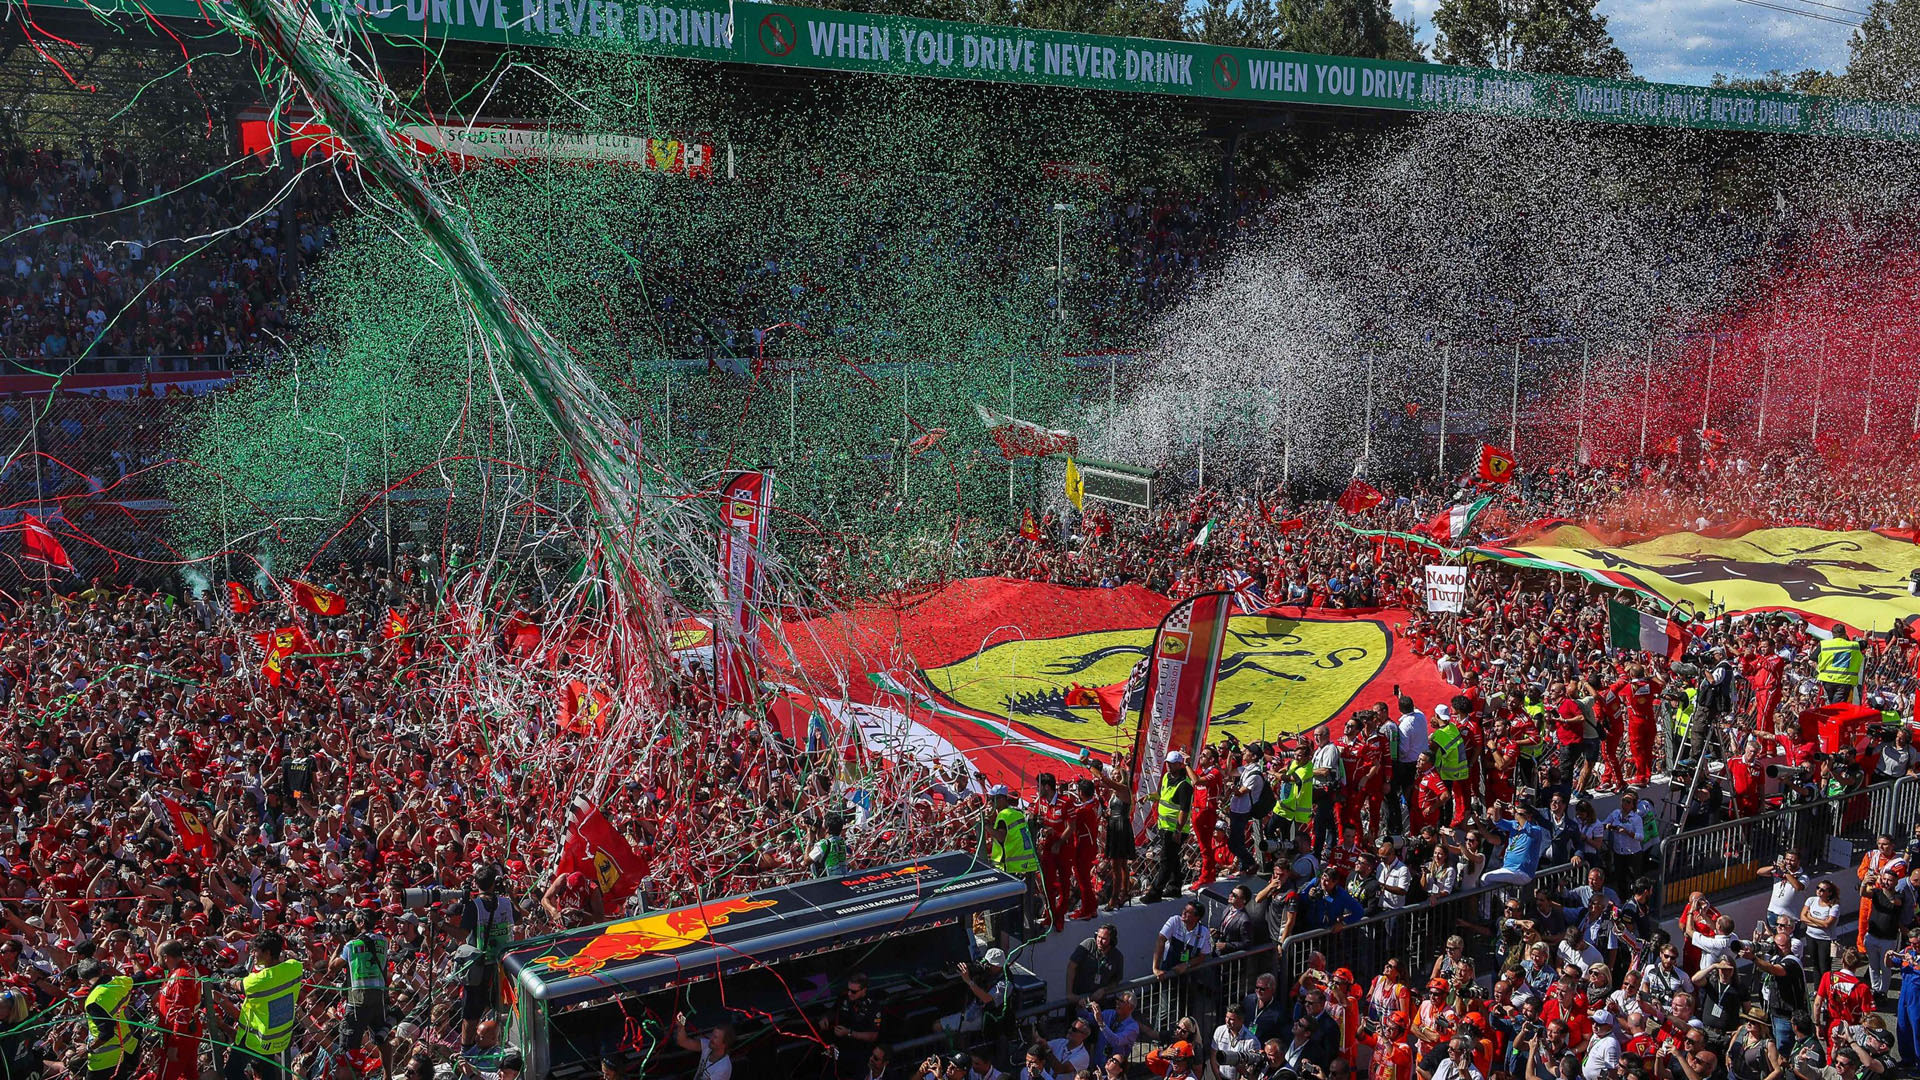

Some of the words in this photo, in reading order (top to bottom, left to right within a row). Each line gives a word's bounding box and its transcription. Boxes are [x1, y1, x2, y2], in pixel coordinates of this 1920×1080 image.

[522, 0, 624, 40] NEVER
[638, 4, 733, 50] DRINK
[807, 20, 891, 62] WHEN
[900, 28, 953, 68] YOU
[963, 35, 1037, 74] DRIVE
[1044, 42, 1117, 80] NEVER
[1125, 50, 1194, 86] DRINK
[1248, 59, 1309, 93] WHEN
[1314, 64, 1355, 96] YOU
[1361, 68, 1416, 100] DRIVE
[1421, 73, 1477, 103] NEVER
[1575, 86, 1623, 115] WHEN
[1629, 91, 1660, 118] YOU
[1663, 94, 1706, 121] DRIVE
[1710, 97, 1755, 123] NEVER
[1759, 101, 1801, 126] DRINK
[448, 129, 524, 145] SCUDERIA
[596, 135, 631, 149] CLUB
[1426, 570, 1466, 586] NAMO
[1166, 664, 1180, 698] Passion
[1149, 702, 1164, 751] FERRARI
[1159, 662, 1170, 696] CLUB
[841, 876, 869, 887] Red
[867, 871, 894, 883] Bull
[835, 893, 919, 915] REDBULLRACING.COM
